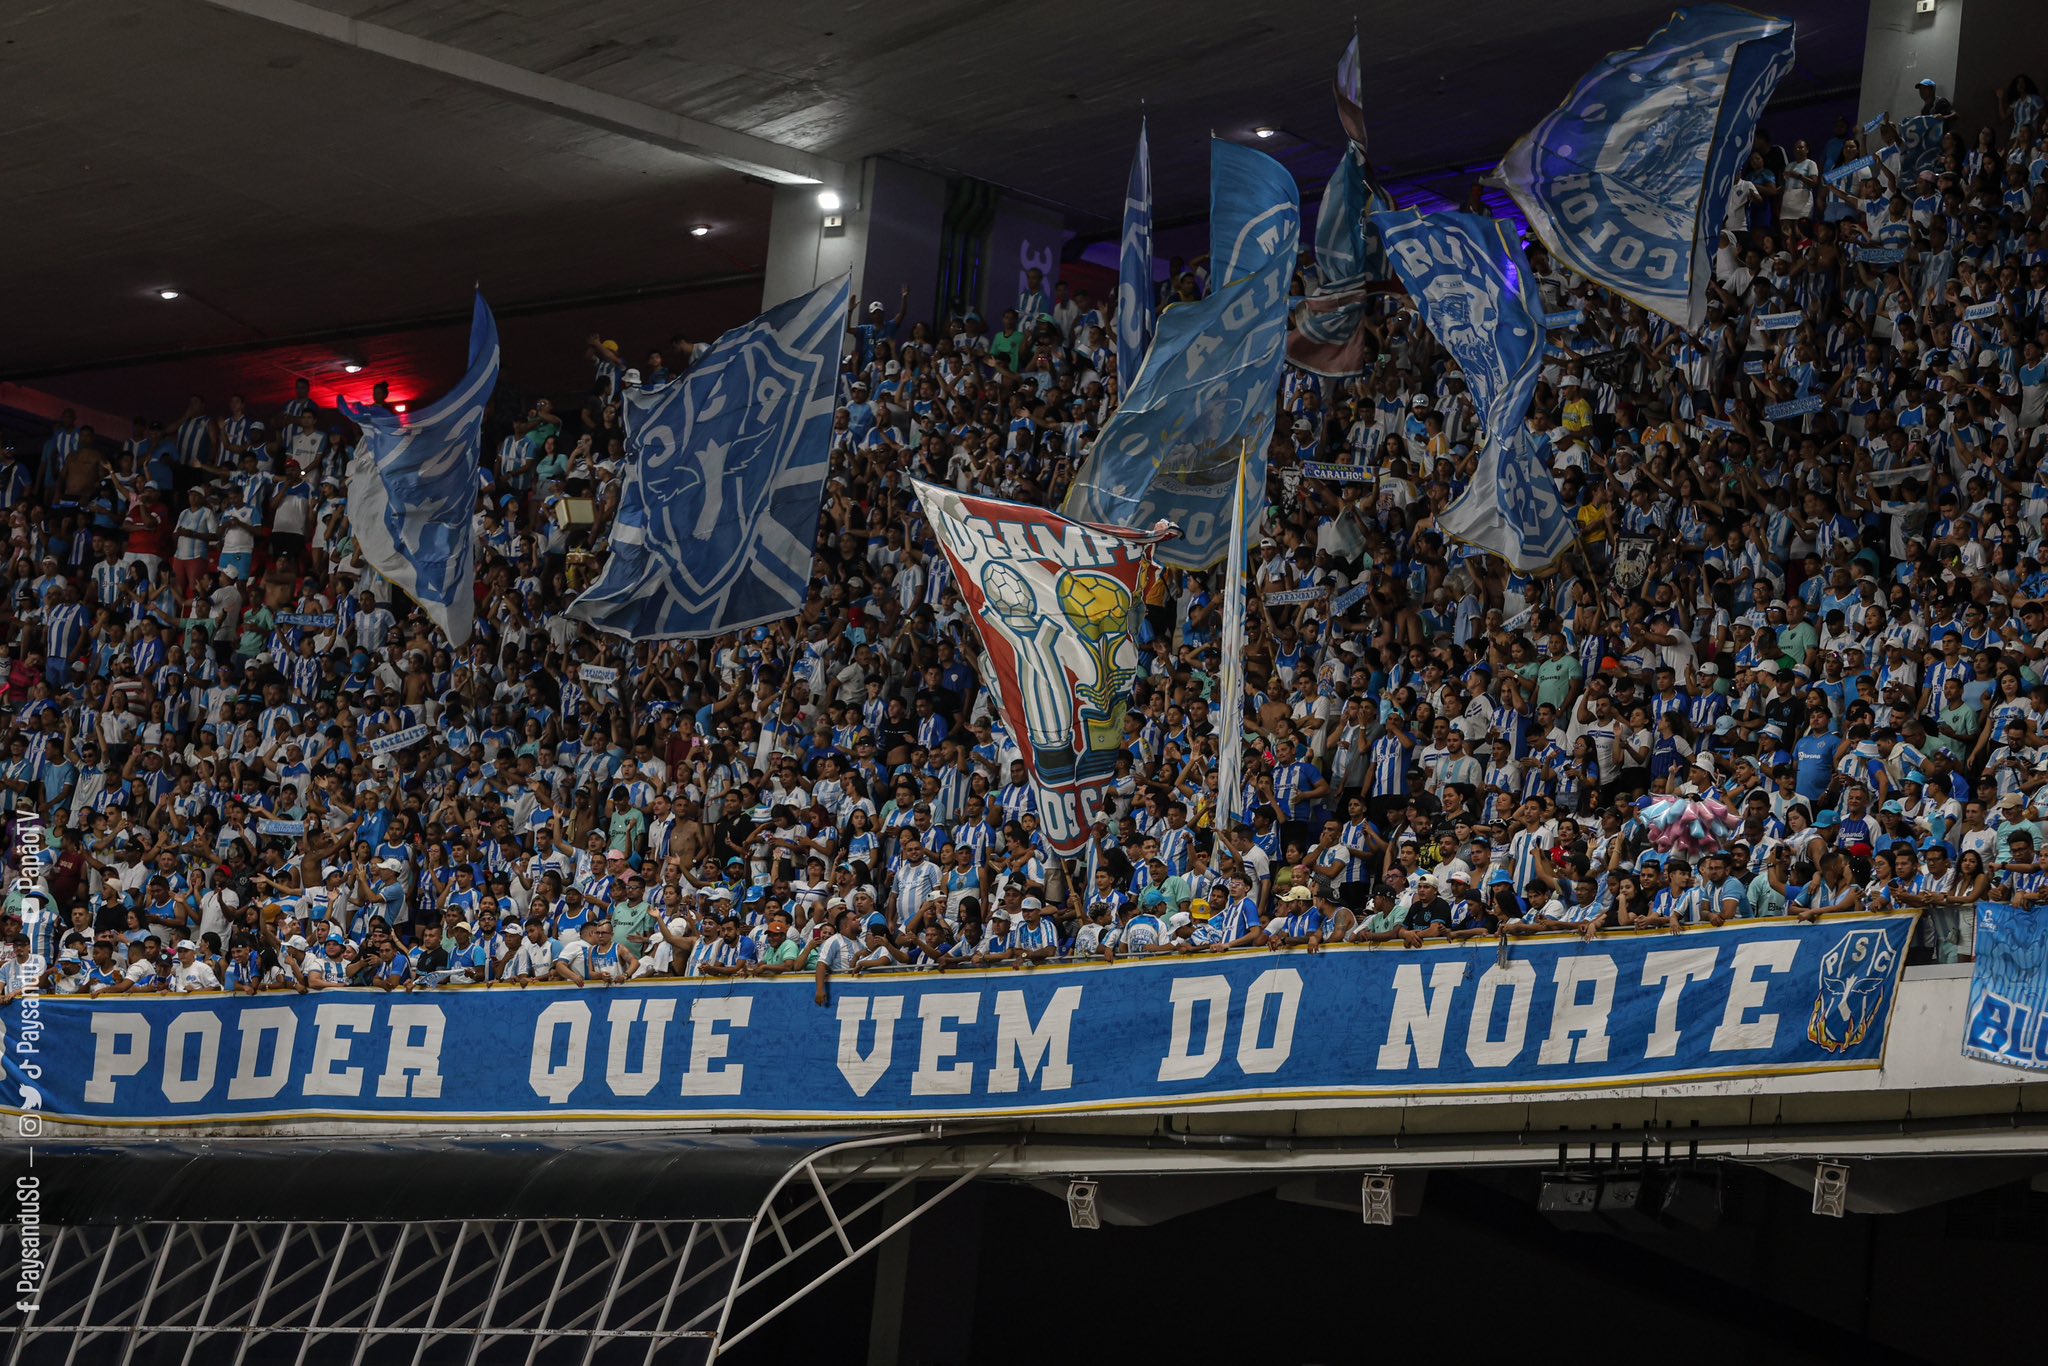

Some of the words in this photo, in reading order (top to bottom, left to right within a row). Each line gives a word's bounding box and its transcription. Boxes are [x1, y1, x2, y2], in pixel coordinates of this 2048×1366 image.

[1313, 469, 1362, 480] CARALHO!
[84, 1003, 448, 1103] PODER
[528, 996, 754, 1104] QUE
[835, 985, 1083, 1097] VEM
[1157, 968, 1304, 1082] DO
[1375, 938, 1801, 1070] NORTE
